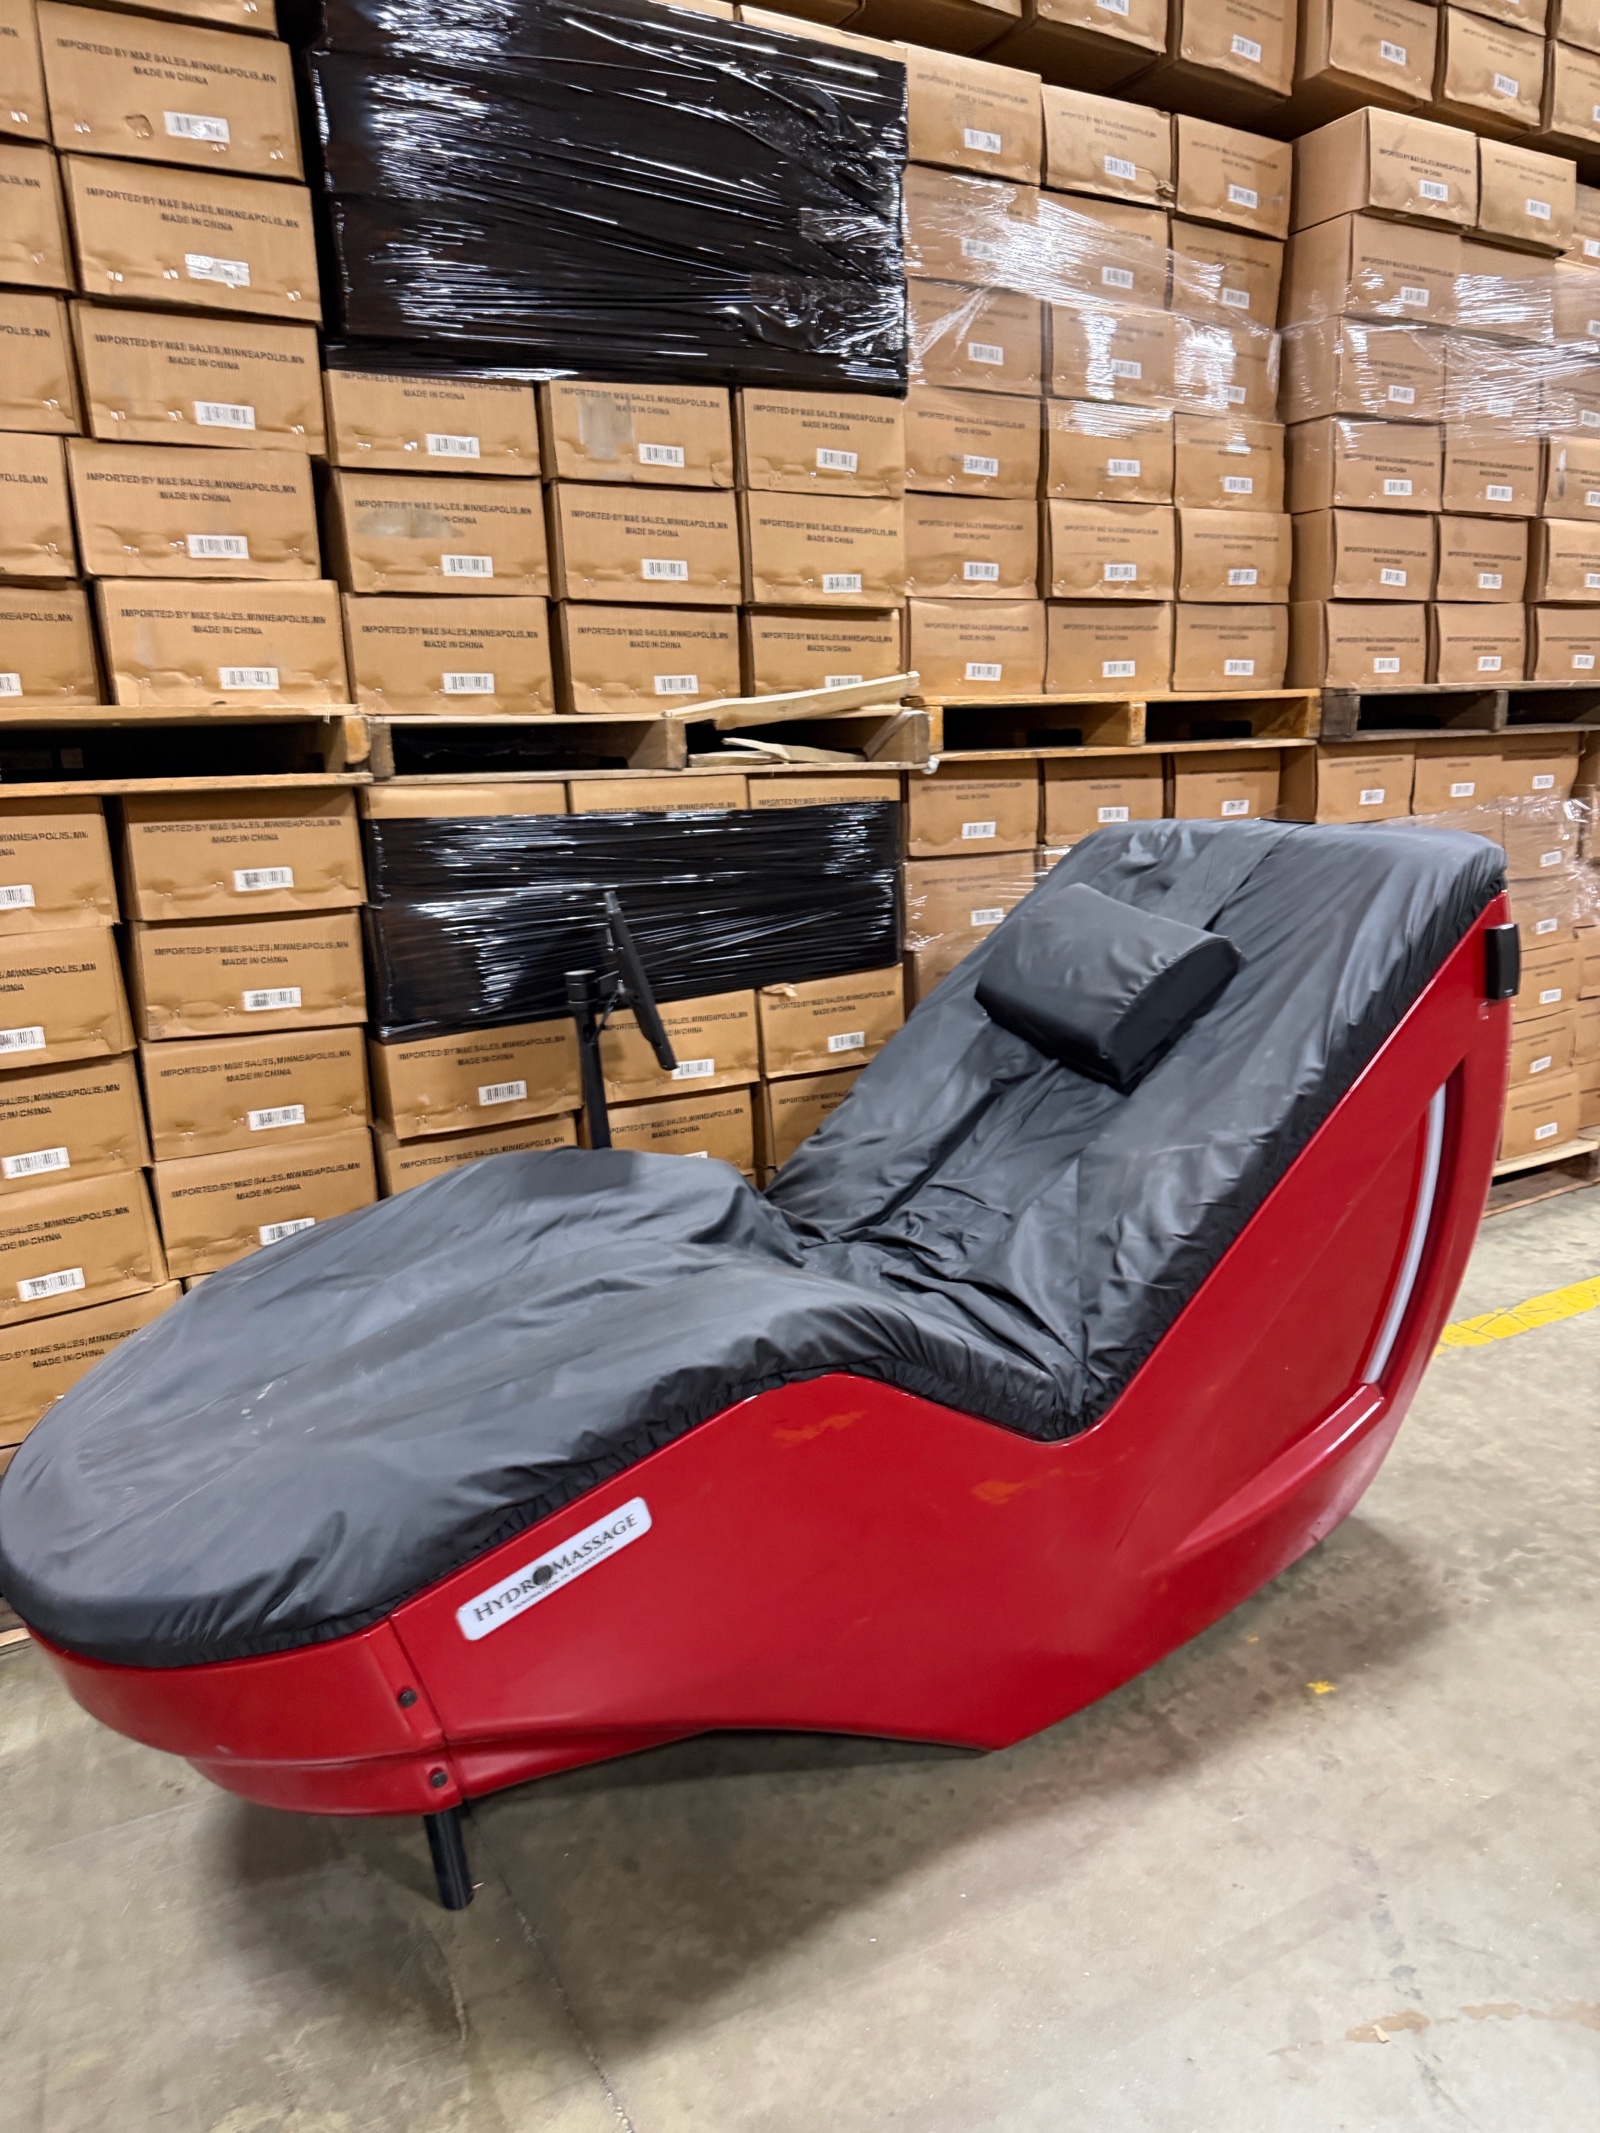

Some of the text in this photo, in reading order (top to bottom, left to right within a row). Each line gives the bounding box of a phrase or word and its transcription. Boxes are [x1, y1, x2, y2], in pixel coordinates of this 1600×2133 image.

[56, 38, 113, 55] IMPORTED
[114, 48, 128, 58] BY
[134, 66, 209, 85] MADE IN CHINA
[86, 187, 142, 203] IMPORTED
[142, 196, 156, 205] BY
[161, 213, 233, 231] MADE IN CHINA
[94, 334, 149, 347] IMPORTED
[150, 340, 163, 349] BY
[168, 356, 240, 370] MADE IN CHINA
[439, 392, 465, 400] CHINA
[646, 407, 670, 415] CHINA
[754, 404, 790, 414] IMPORTED
[86, 472, 141, 483] IMPORTED
[142, 476, 155, 484] BY
[159, 491, 189, 500] MADE
[201, 494, 231, 502] CHINA
[452, 516, 477, 524] CHINA
[571, 510, 612, 520] IMPORTED
[760, 518, 795, 528] IMPORTED
[625, 527, 647, 535] MADE
[657, 529, 680, 538] CHINA
[120, 609, 174, 618] IMPORTED
[362, 625, 407, 634] IMPORTED
[142, 824, 194, 833] IMPORTED
[154, 947, 205, 955] IMPORTED
[398, 1049, 443, 1060] IMPORTED
[458, 1057, 481, 1066] MADE
[491, 1053, 515, 1062] CHINA
[160, 1066, 209, 1077] IMPORTED
[226, 1073, 252, 1082] MADE
[265, 1068, 292, 1078] CHINA
[652, 1130, 671, 1139] MADE
[680, 1125, 700, 1134] CHINA
[399, 1156, 444, 1170] IMPORTED
[170, 1184, 220, 1198] IMPORTED
[220, 1182, 233, 1190] BY
[236, 1190, 262, 1200] MADE
[274, 1183, 302, 1194] CHINA
[32, 1348, 106, 1368] MADE IN CHINA
[474, 1514, 638, 1622] HYDROMASSAGE
